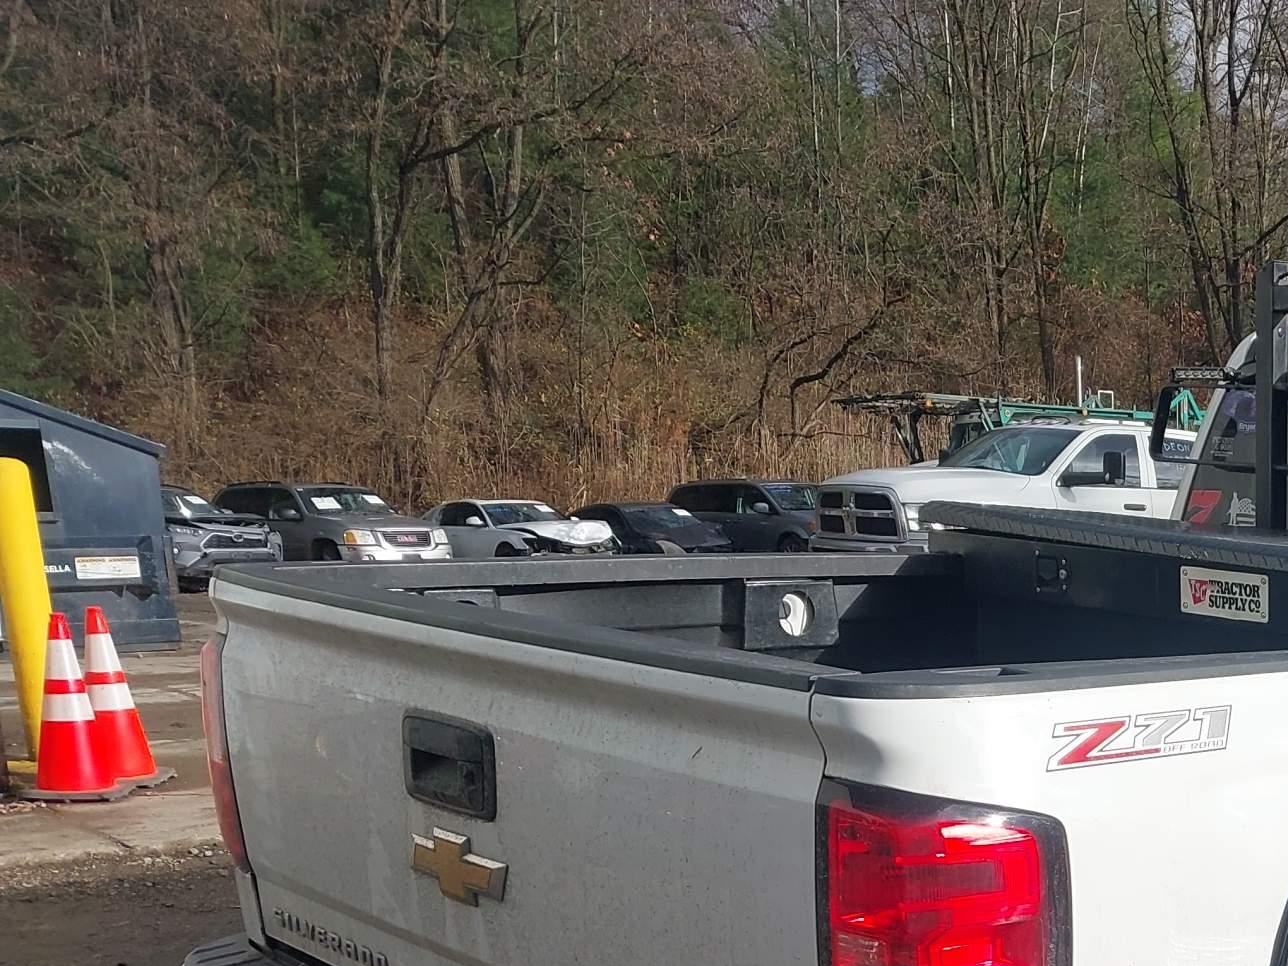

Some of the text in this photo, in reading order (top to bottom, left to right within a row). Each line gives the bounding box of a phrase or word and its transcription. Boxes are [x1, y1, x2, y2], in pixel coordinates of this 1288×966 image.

[1187, 489, 1222, 525] 7
[1208, 579, 1261, 599] TRACTOR
[1208, 594, 1248, 611] SUPPLY
[1046, 705, 1232, 772] Z71
[1163, 738, 1224, 753] OFF ROAD
